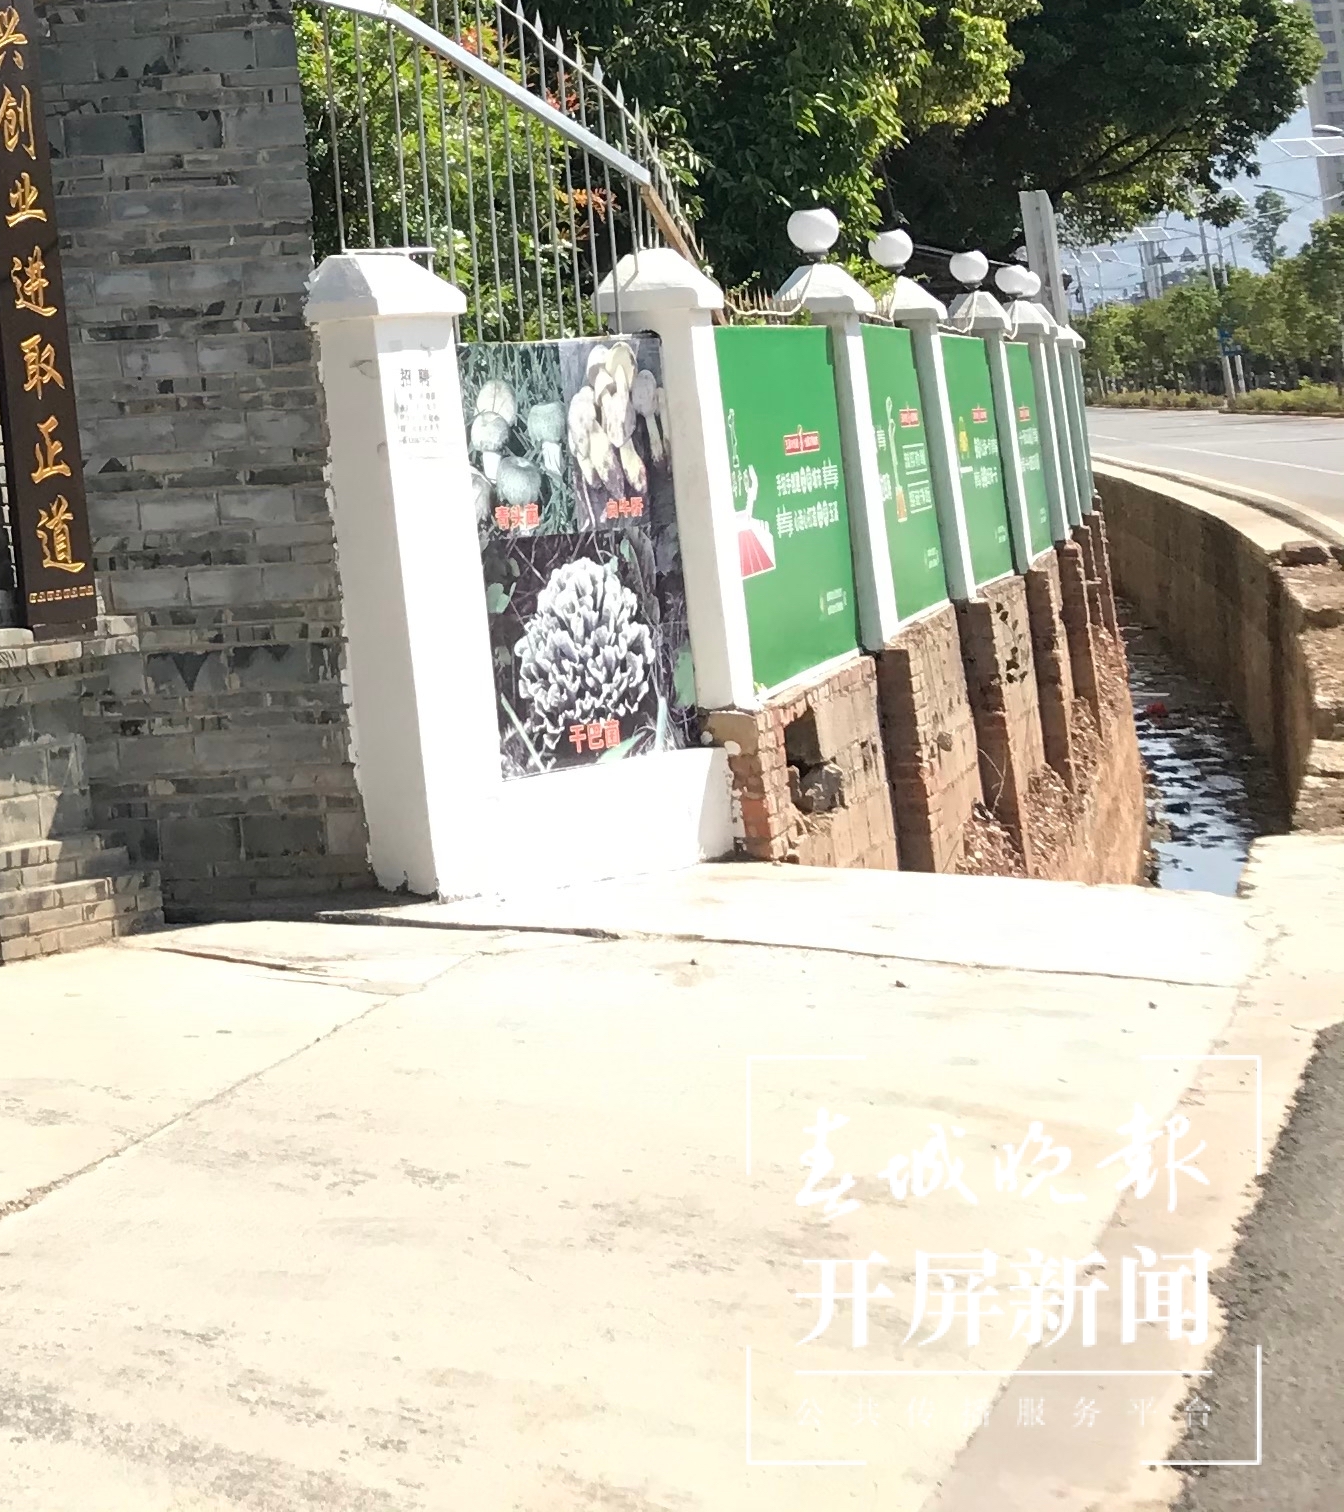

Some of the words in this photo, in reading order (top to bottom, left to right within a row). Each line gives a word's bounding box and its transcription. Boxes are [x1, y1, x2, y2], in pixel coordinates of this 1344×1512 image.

[494, 503, 541, 530] 青头菌
[568, 718, 621, 754] 干巴菌
